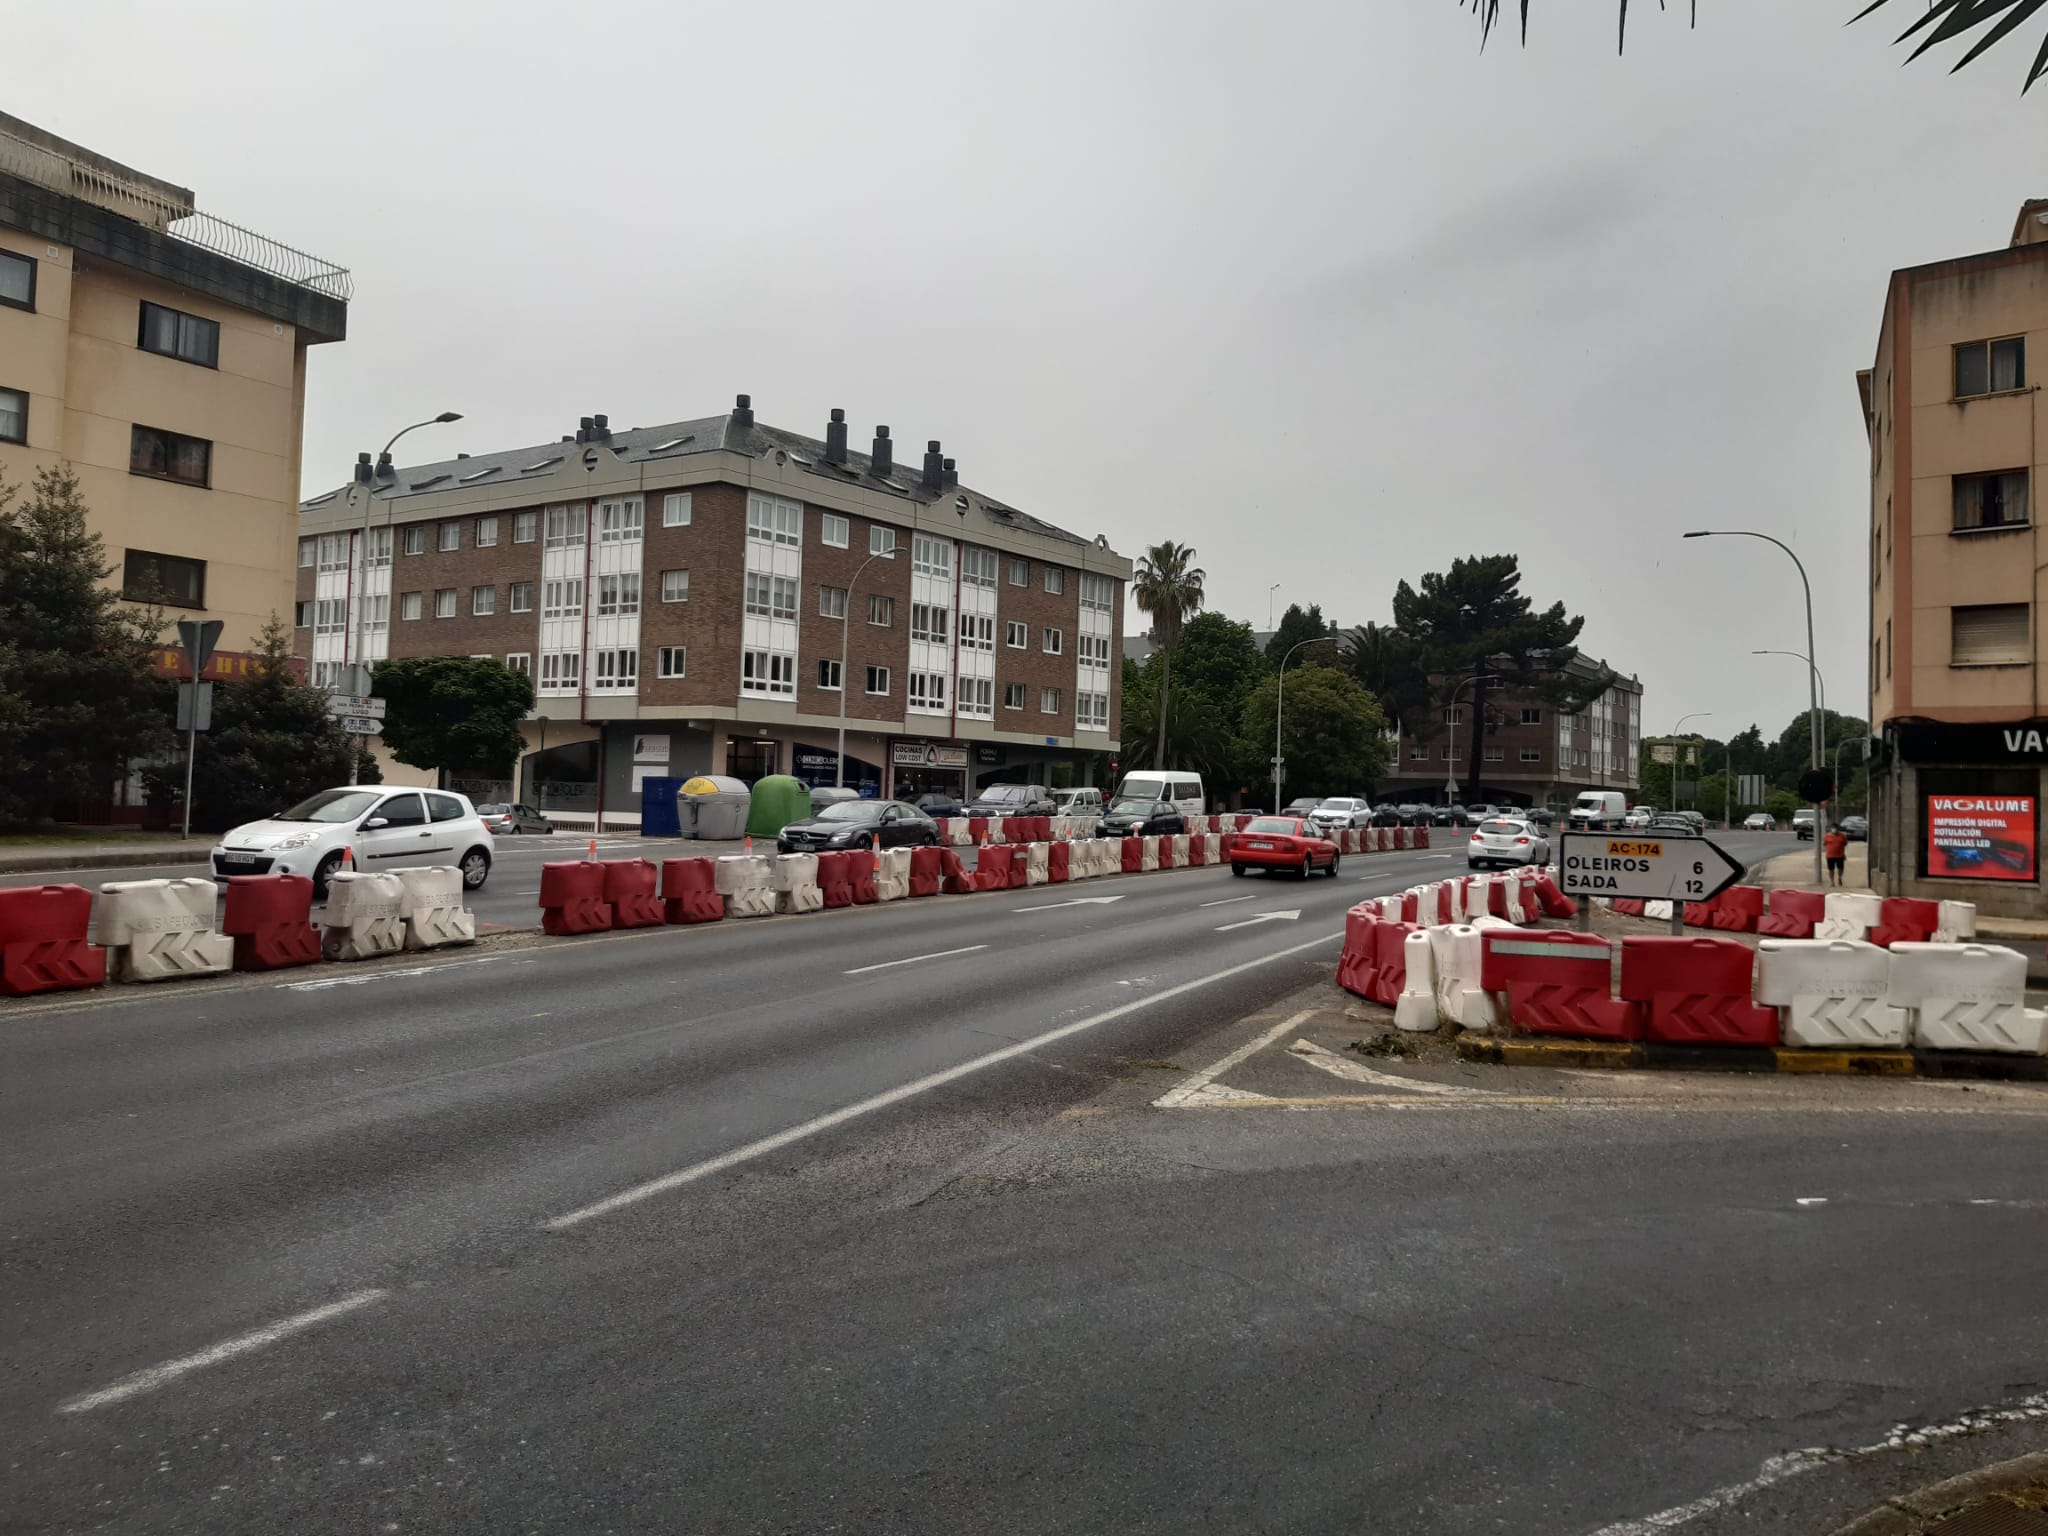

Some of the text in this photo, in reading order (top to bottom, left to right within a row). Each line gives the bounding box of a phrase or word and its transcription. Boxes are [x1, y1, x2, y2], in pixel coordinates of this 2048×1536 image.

[2003, 729, 2048, 753] VA
[895, 745, 922, 754] COCINAS
[908, 754, 922, 762] COST
[1934, 799, 2030, 812] VAGALUME
[1934, 817, 2008, 828] IMPRESIÓN DIGITAL
[1934, 827, 1981, 837] ROTULACIÓN
[1934, 838, 1991, 848] PANTALLAS LED
[1609, 843, 1661, 855] AC-174
[1566, 856, 1704, 875] OLEIROS 6
[1567, 874, 1704, 894] SADA 12
